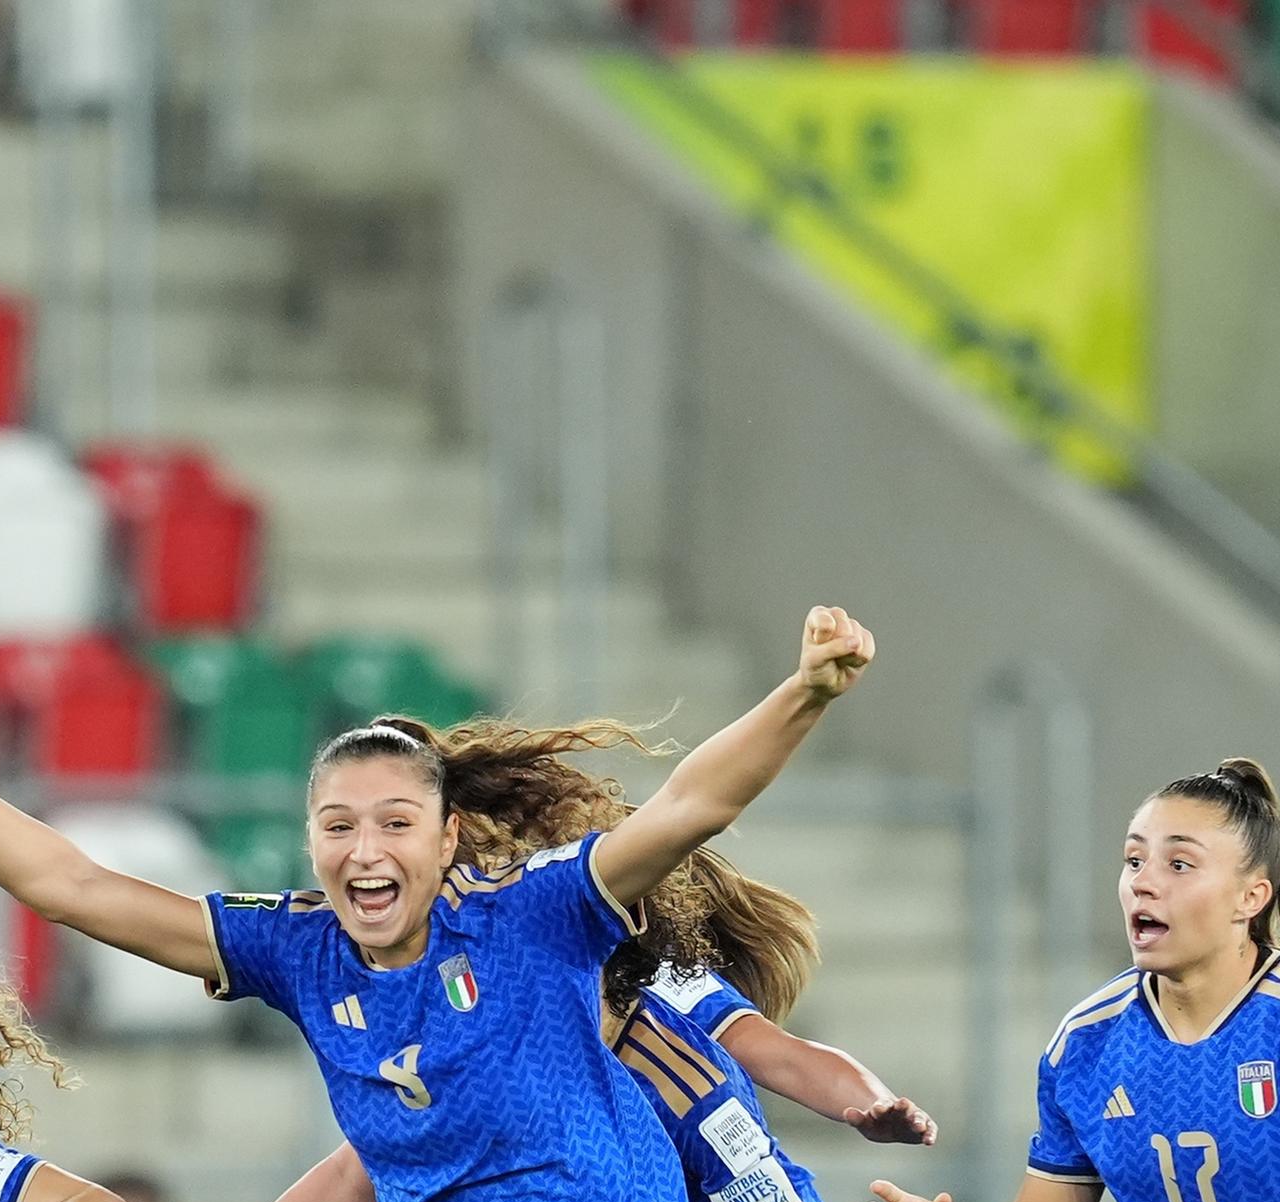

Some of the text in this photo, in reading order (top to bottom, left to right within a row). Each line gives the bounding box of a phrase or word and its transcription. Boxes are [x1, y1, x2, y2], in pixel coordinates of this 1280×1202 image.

[1240, 1065, 1272, 1079] ITALIA
[713, 1110, 743, 1136] FOOTBALL
[720, 1118, 752, 1146] UNITES
[729, 1144, 743, 1158] the
[720, 1168, 769, 1201] FOOTBALL
